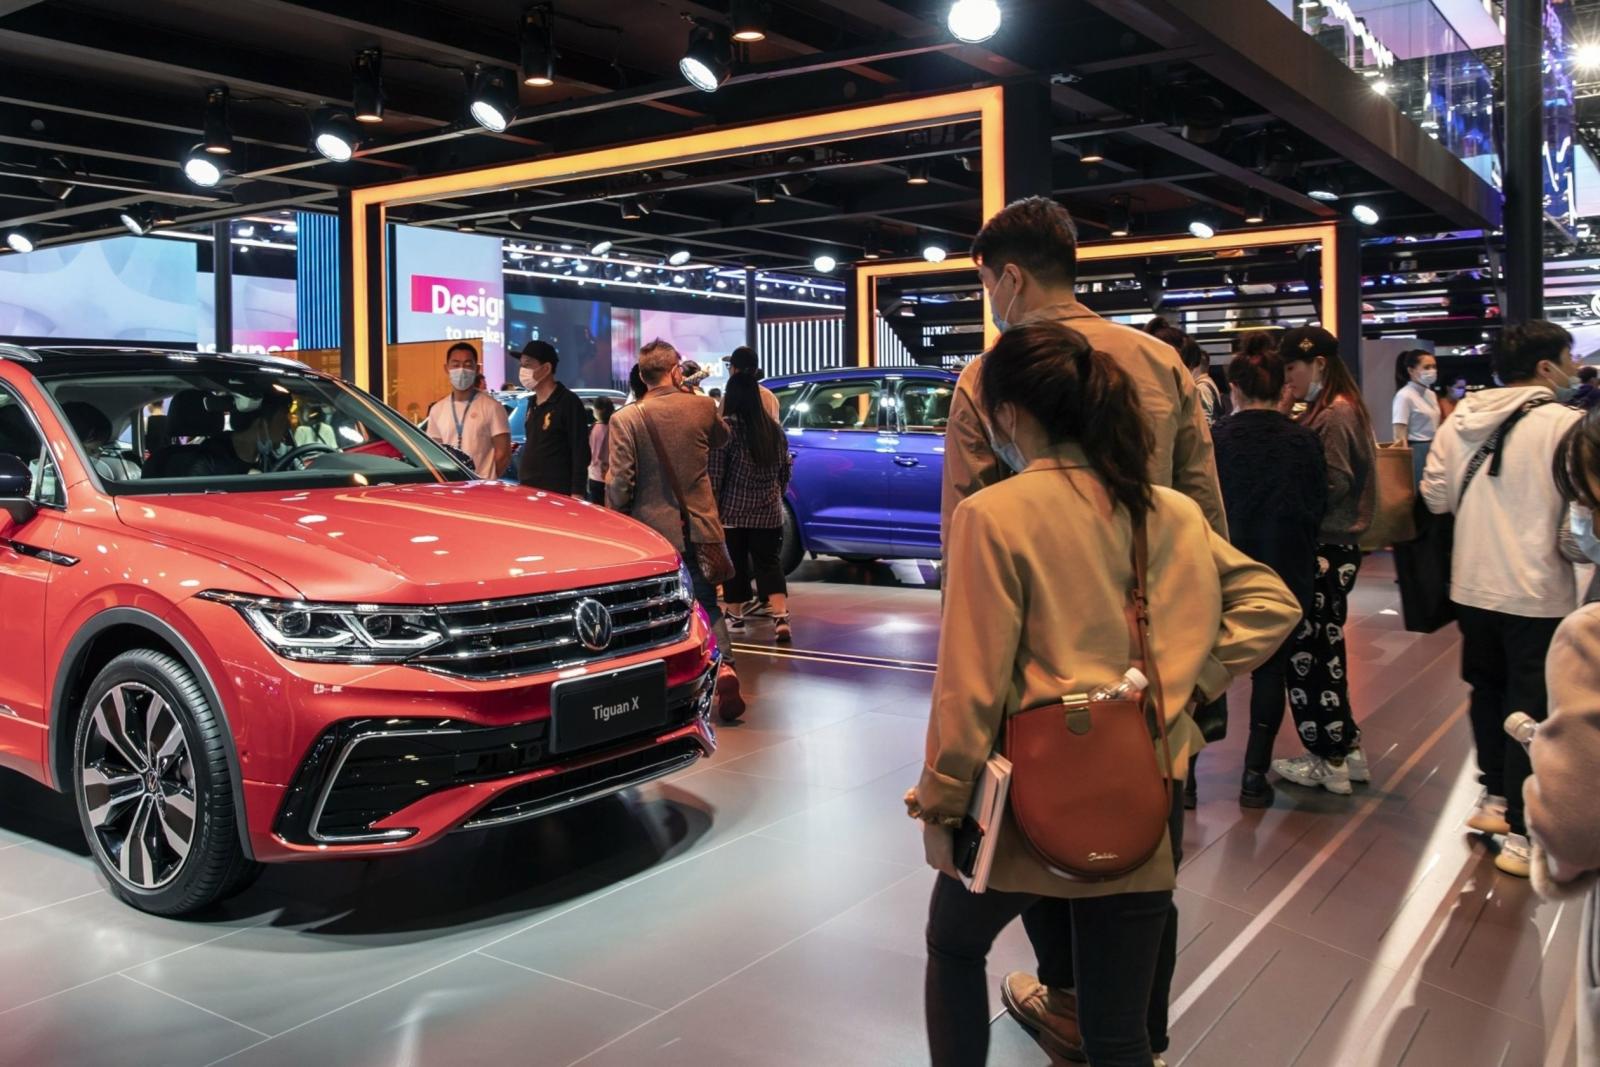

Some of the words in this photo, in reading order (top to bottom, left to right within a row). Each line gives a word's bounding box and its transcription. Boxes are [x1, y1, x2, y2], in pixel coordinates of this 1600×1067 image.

[445, 326, 462, 340] to
[464, 326, 500, 343] make
[592, 702, 630, 721] Tiguan
[631, 696, 639, 711] X
